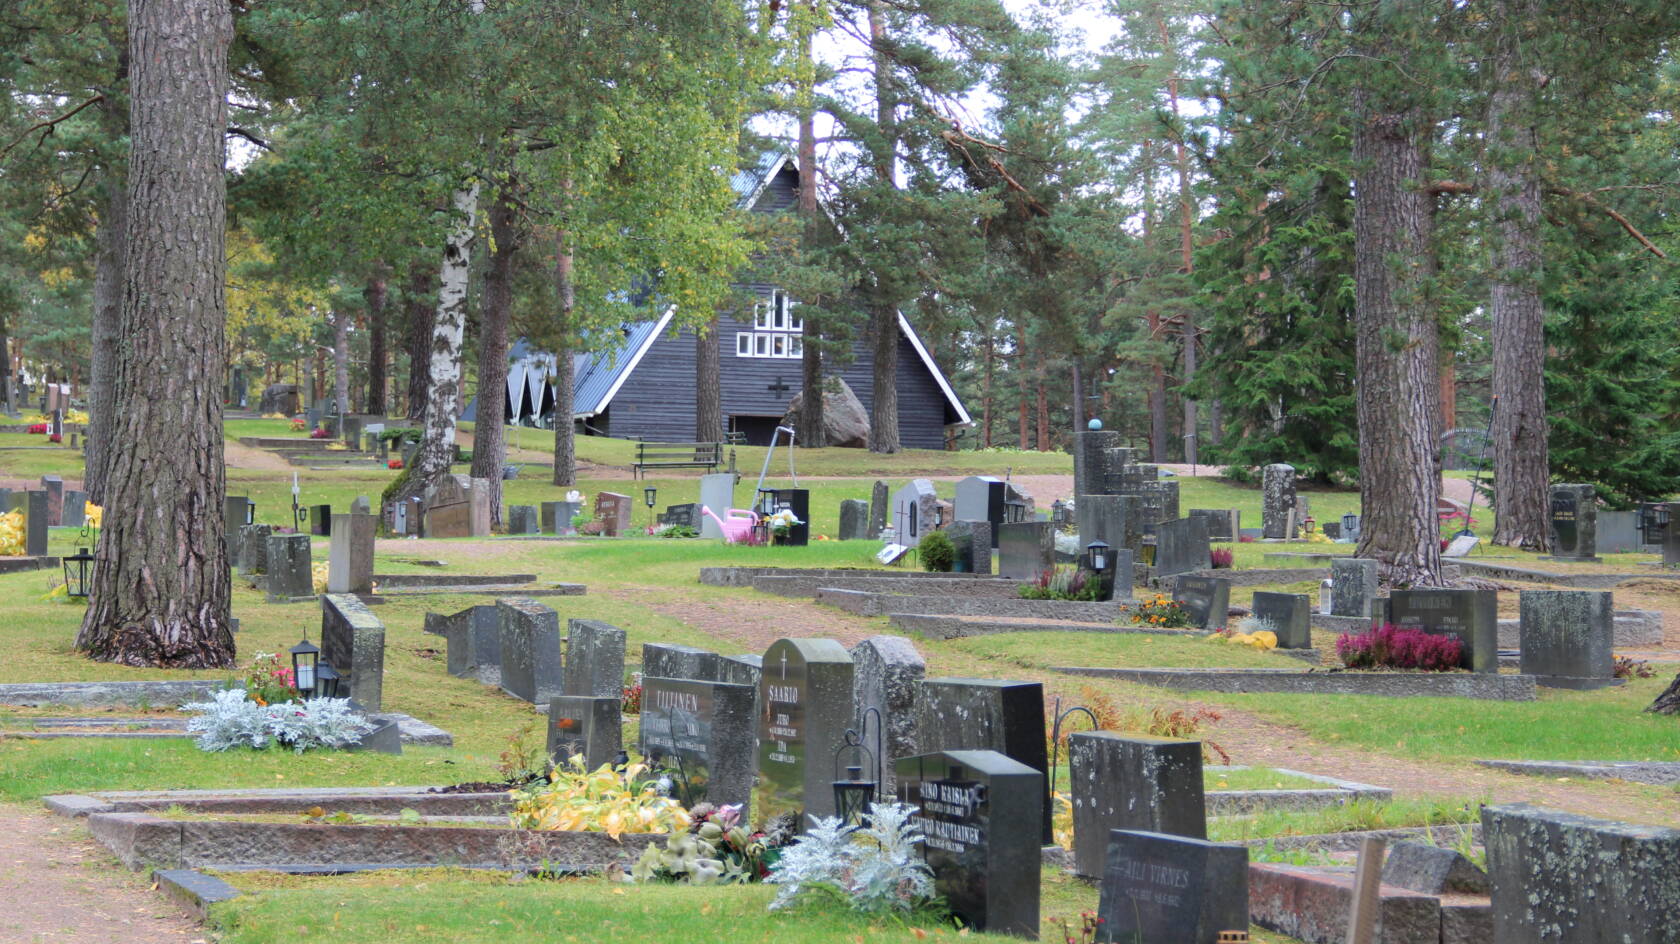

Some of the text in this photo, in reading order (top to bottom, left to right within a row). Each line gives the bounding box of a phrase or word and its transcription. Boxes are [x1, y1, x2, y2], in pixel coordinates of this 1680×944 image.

[769, 685, 798, 704] SAARIO
[920, 781, 938, 800] AINO
[935, 819, 979, 845] RAUTIAINEN
